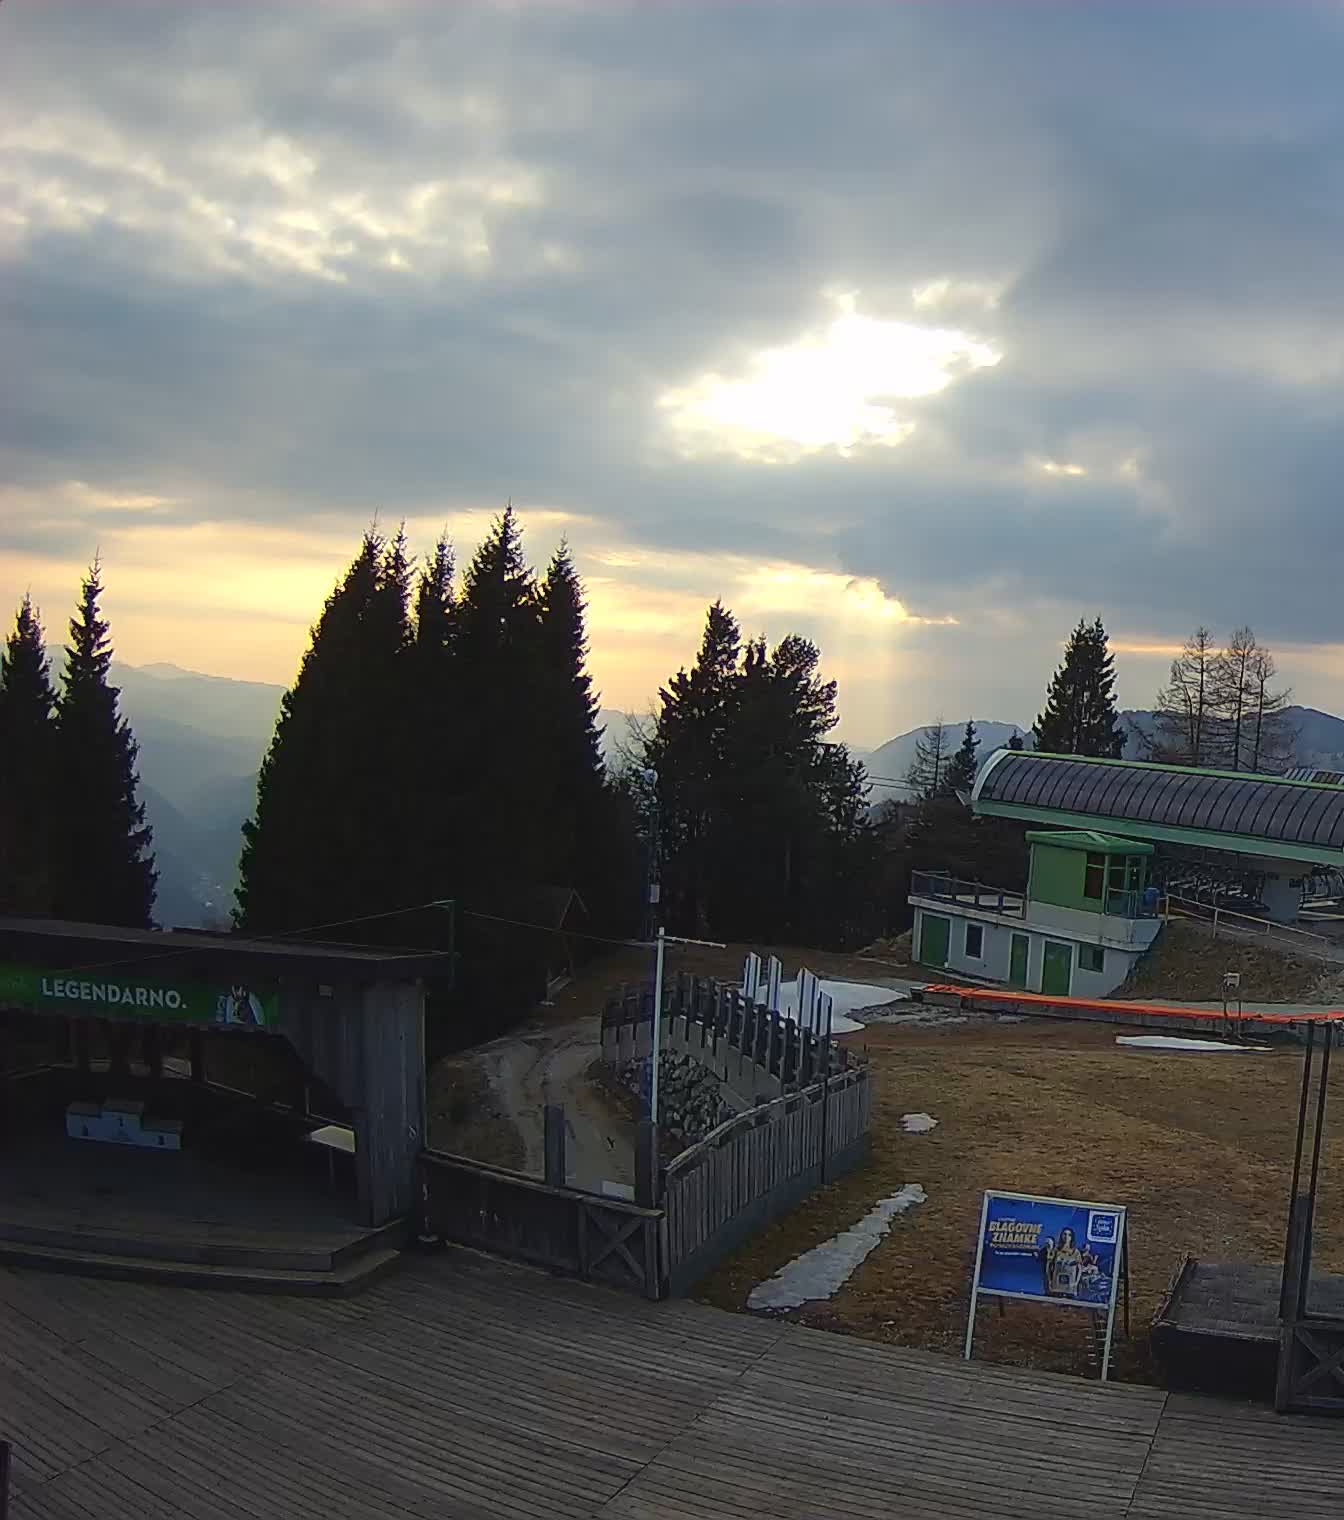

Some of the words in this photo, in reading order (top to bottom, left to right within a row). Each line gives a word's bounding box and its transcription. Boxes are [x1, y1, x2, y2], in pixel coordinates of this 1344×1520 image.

[41, 977, 188, 1009] LEGENDARNO.
[988, 1220, 1043, 1234] BLAGOVNE
[992, 1232, 1038, 1244] ZNAMKE
